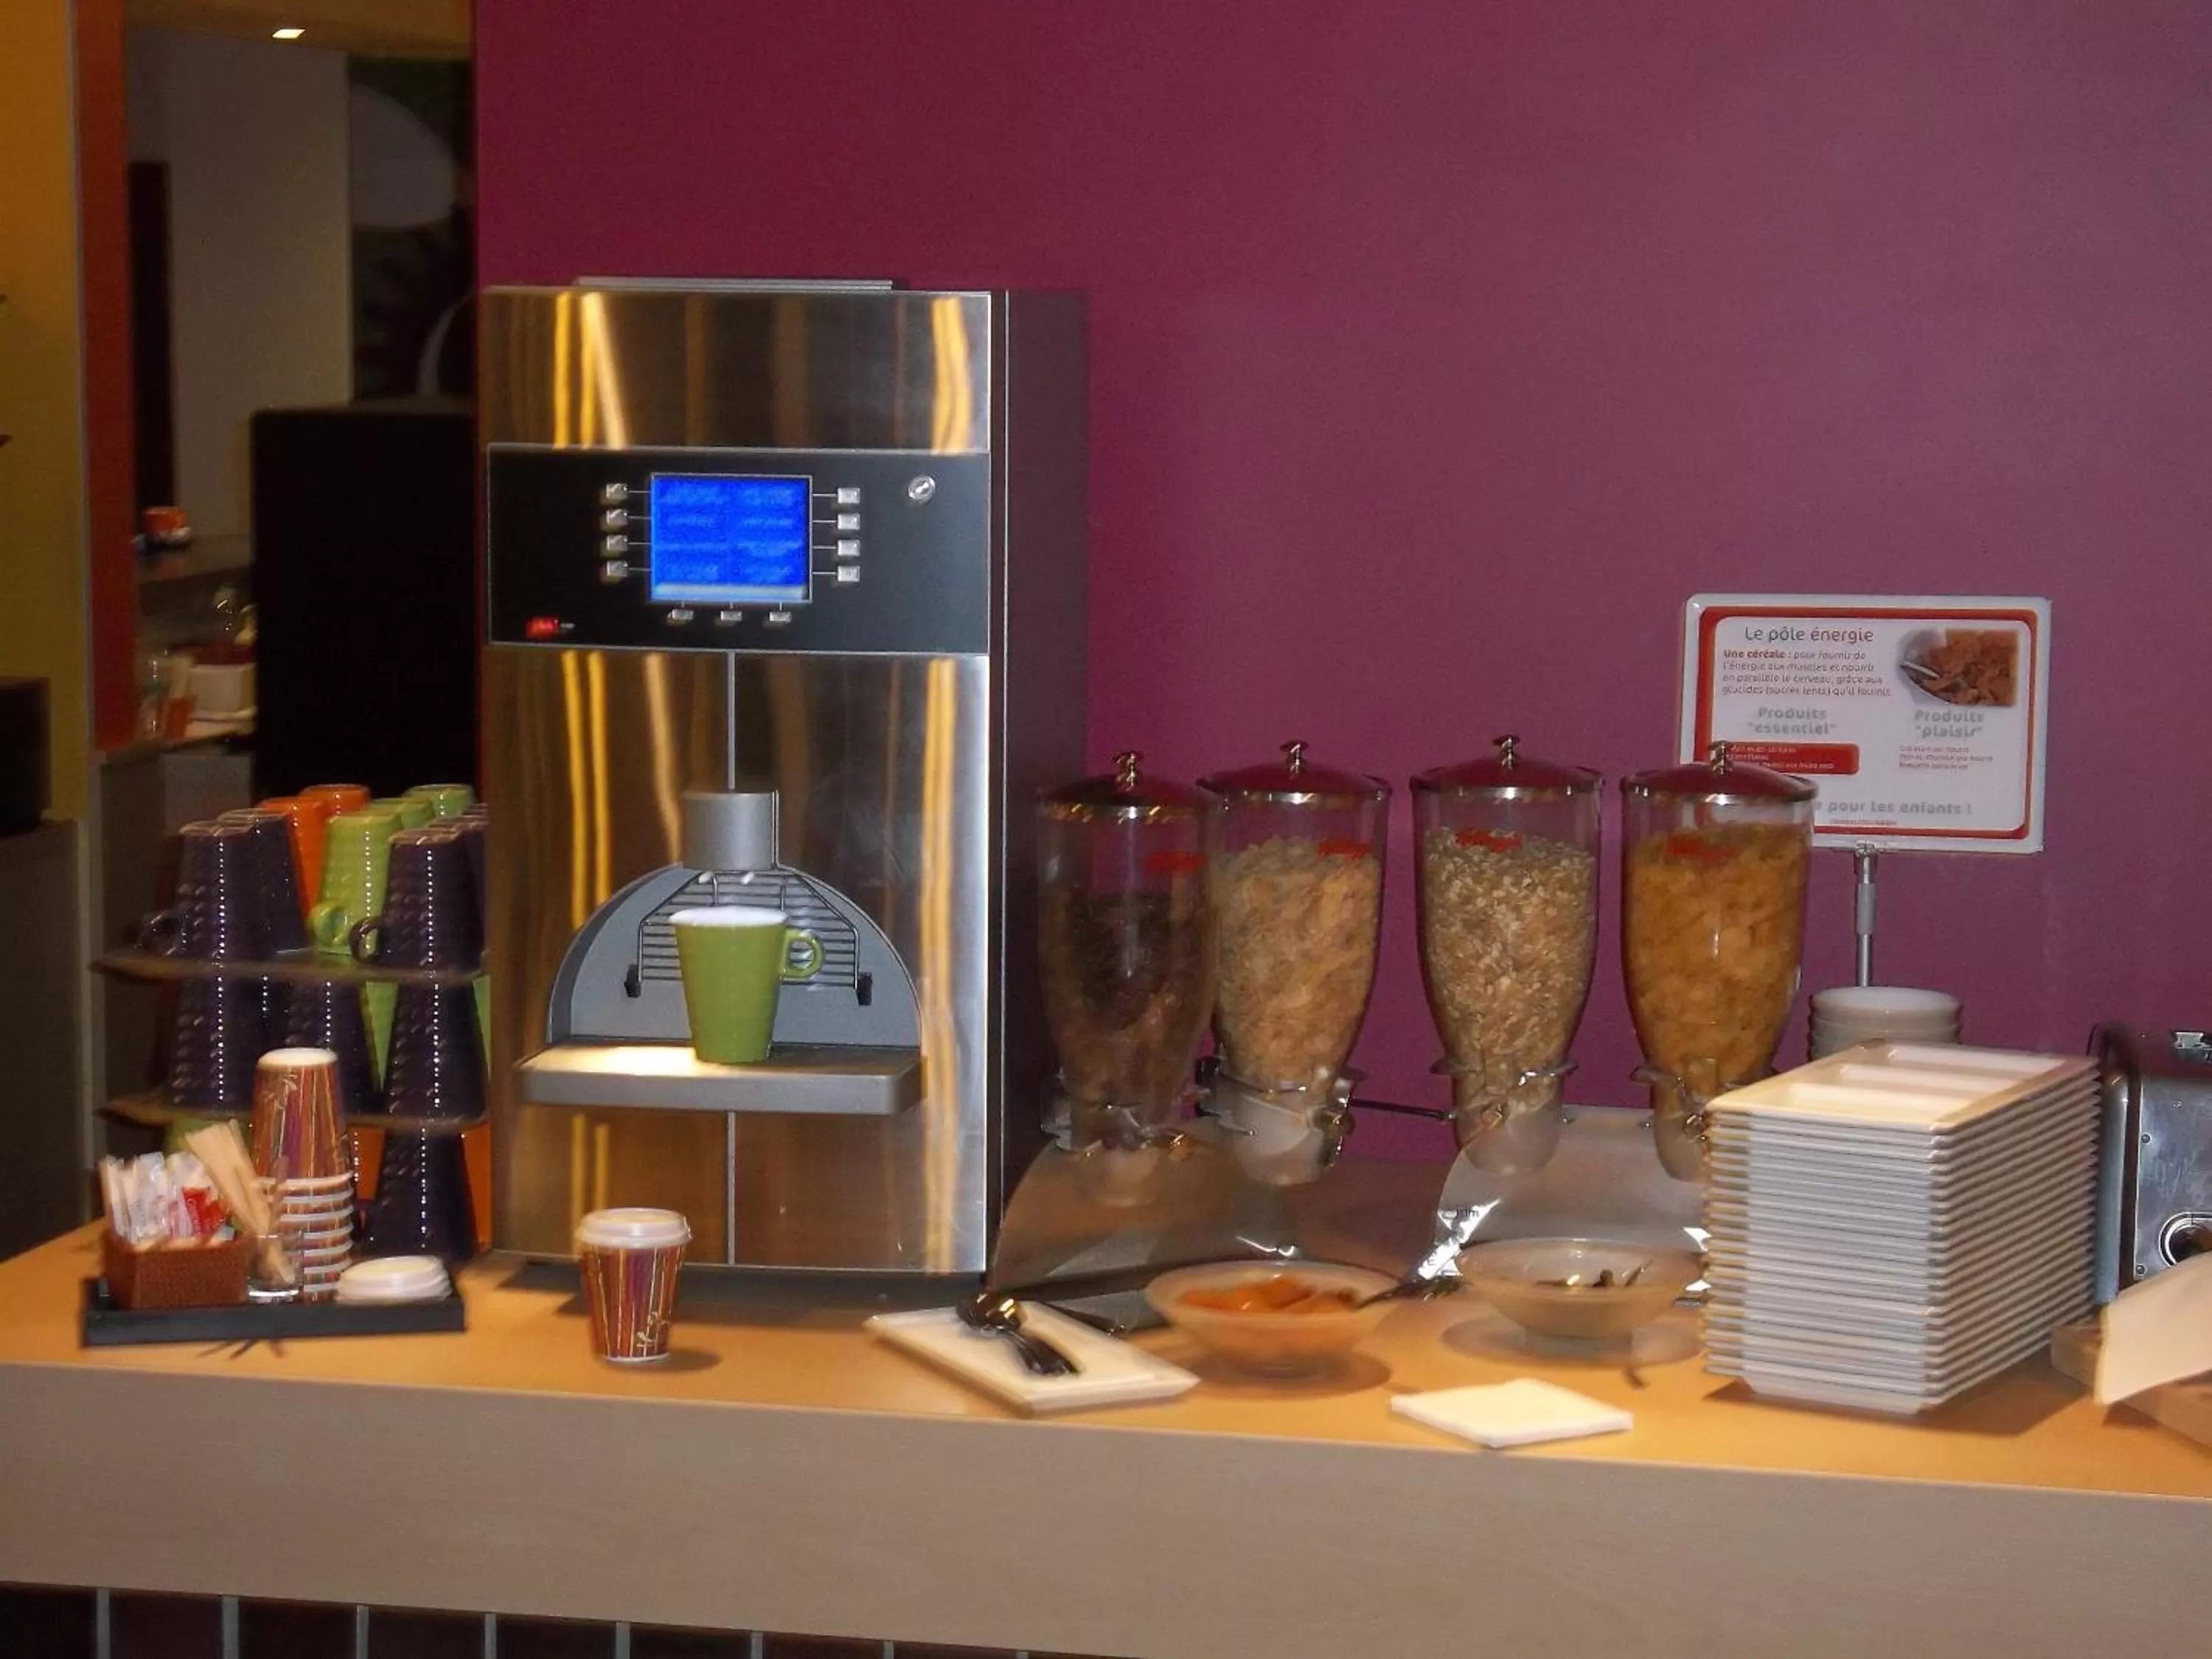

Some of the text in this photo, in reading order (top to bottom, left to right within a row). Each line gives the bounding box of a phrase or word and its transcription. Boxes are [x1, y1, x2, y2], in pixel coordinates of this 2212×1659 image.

[1745, 626, 1874, 644] Le pôle énergie
[1723, 649, 1744, 658] Une
[1747, 649, 1785, 658] céréale
[1794, 652, 1815, 660] pour
[1837, 672, 1863, 685] grâce
[1759, 707, 1827, 719] Produits
[1915, 710, 1984, 722] Produits
[1747, 722, 1837, 734] "essentiel"
[1916, 724, 1983, 738] "plaisir"
[1828, 801, 1865, 813] pour
[1871, 800, 1894, 812] les
[1900, 801, 1961, 814] enfants
